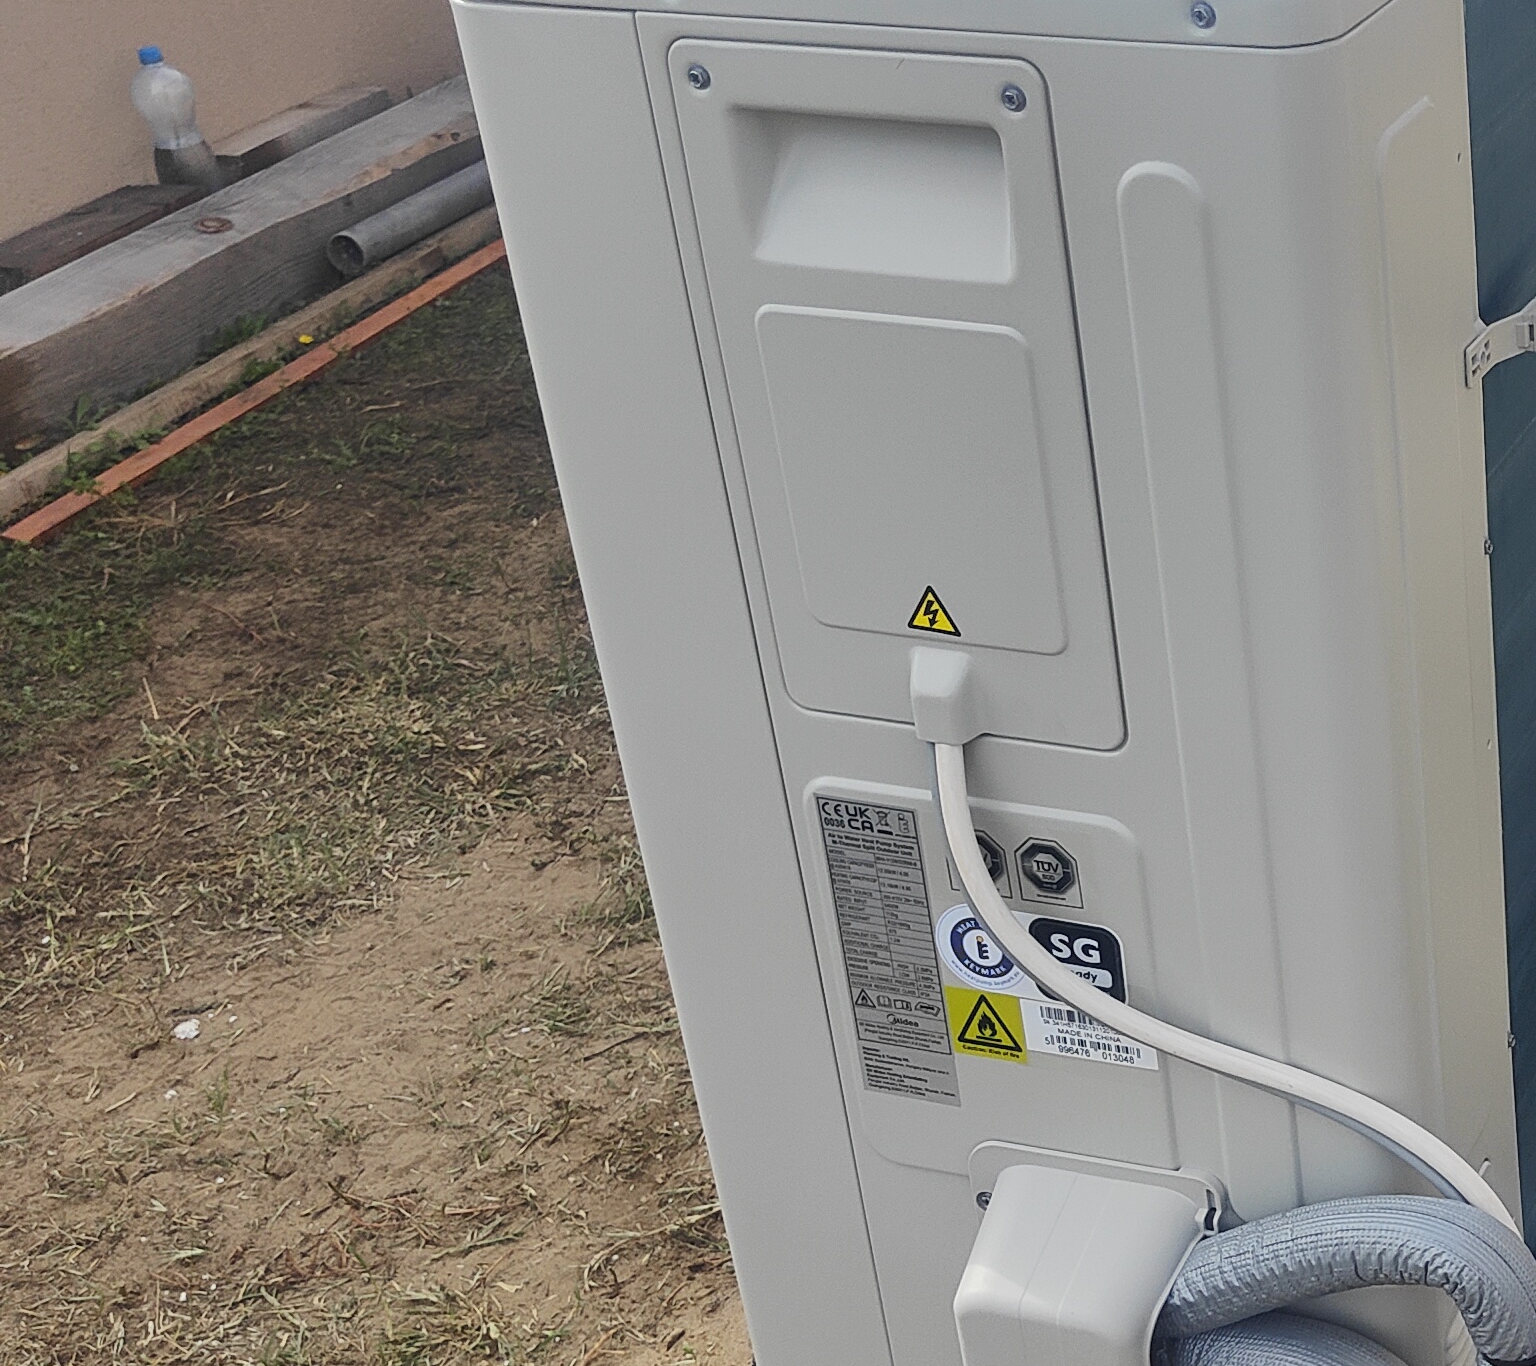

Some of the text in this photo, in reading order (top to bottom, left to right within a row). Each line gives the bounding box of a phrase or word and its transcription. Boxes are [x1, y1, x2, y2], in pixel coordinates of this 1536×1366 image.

[844, 804, 872, 820] UK
[847, 818, 875, 833] CA
[1050, 933, 1101, 964] SG
[963, 958, 1007, 976] KEYMARK
[887, 1013, 919, 1028] Midea
[1057, 1027, 1083, 1038] MADE
[1094, 1033, 1122, 1043] CHINA
[1101, 1051, 1135, 1065] 013048
